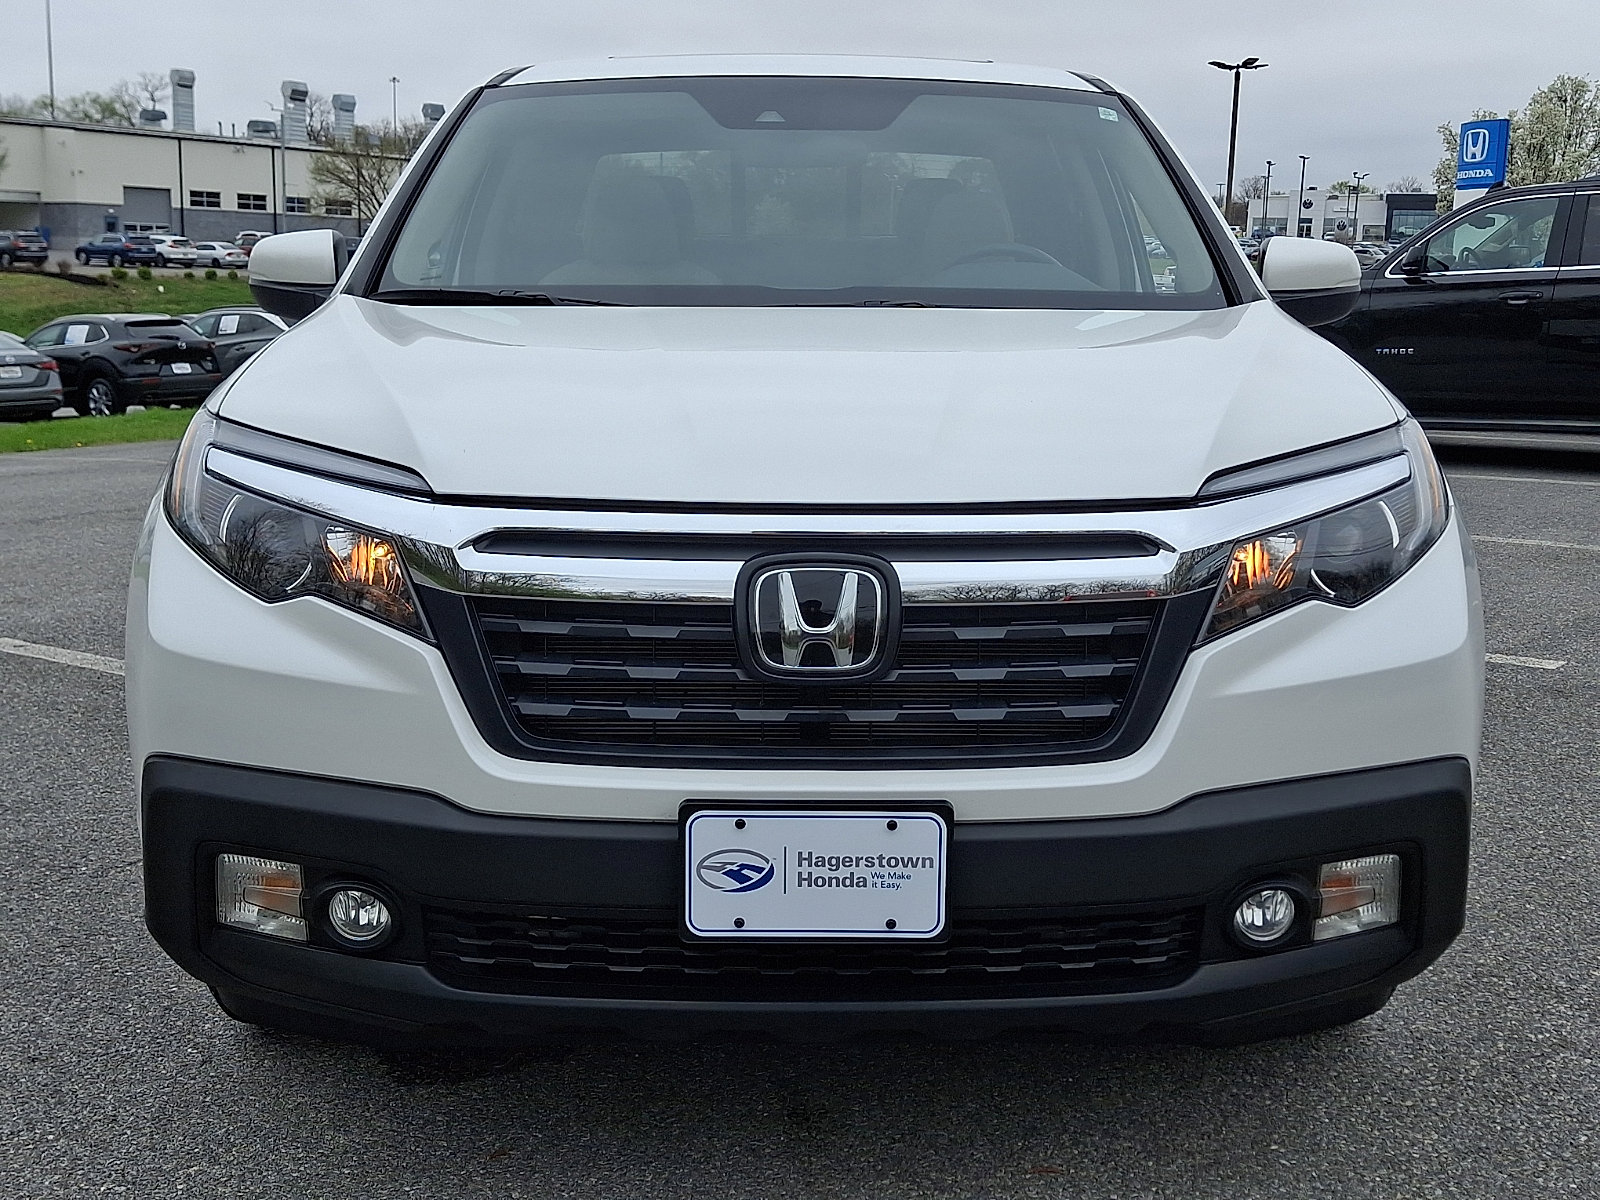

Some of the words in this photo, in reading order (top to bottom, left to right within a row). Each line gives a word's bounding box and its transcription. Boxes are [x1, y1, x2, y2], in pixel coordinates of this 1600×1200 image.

[1457, 169, 1494, 179] HONDA
[797, 851, 934, 872] Hagerstown
[797, 871, 868, 888] Honda
[870, 871, 885, 880] We
[887, 871, 912, 881] Make
[871, 880, 878, 889] it
[880, 880, 902, 891] Easy.
